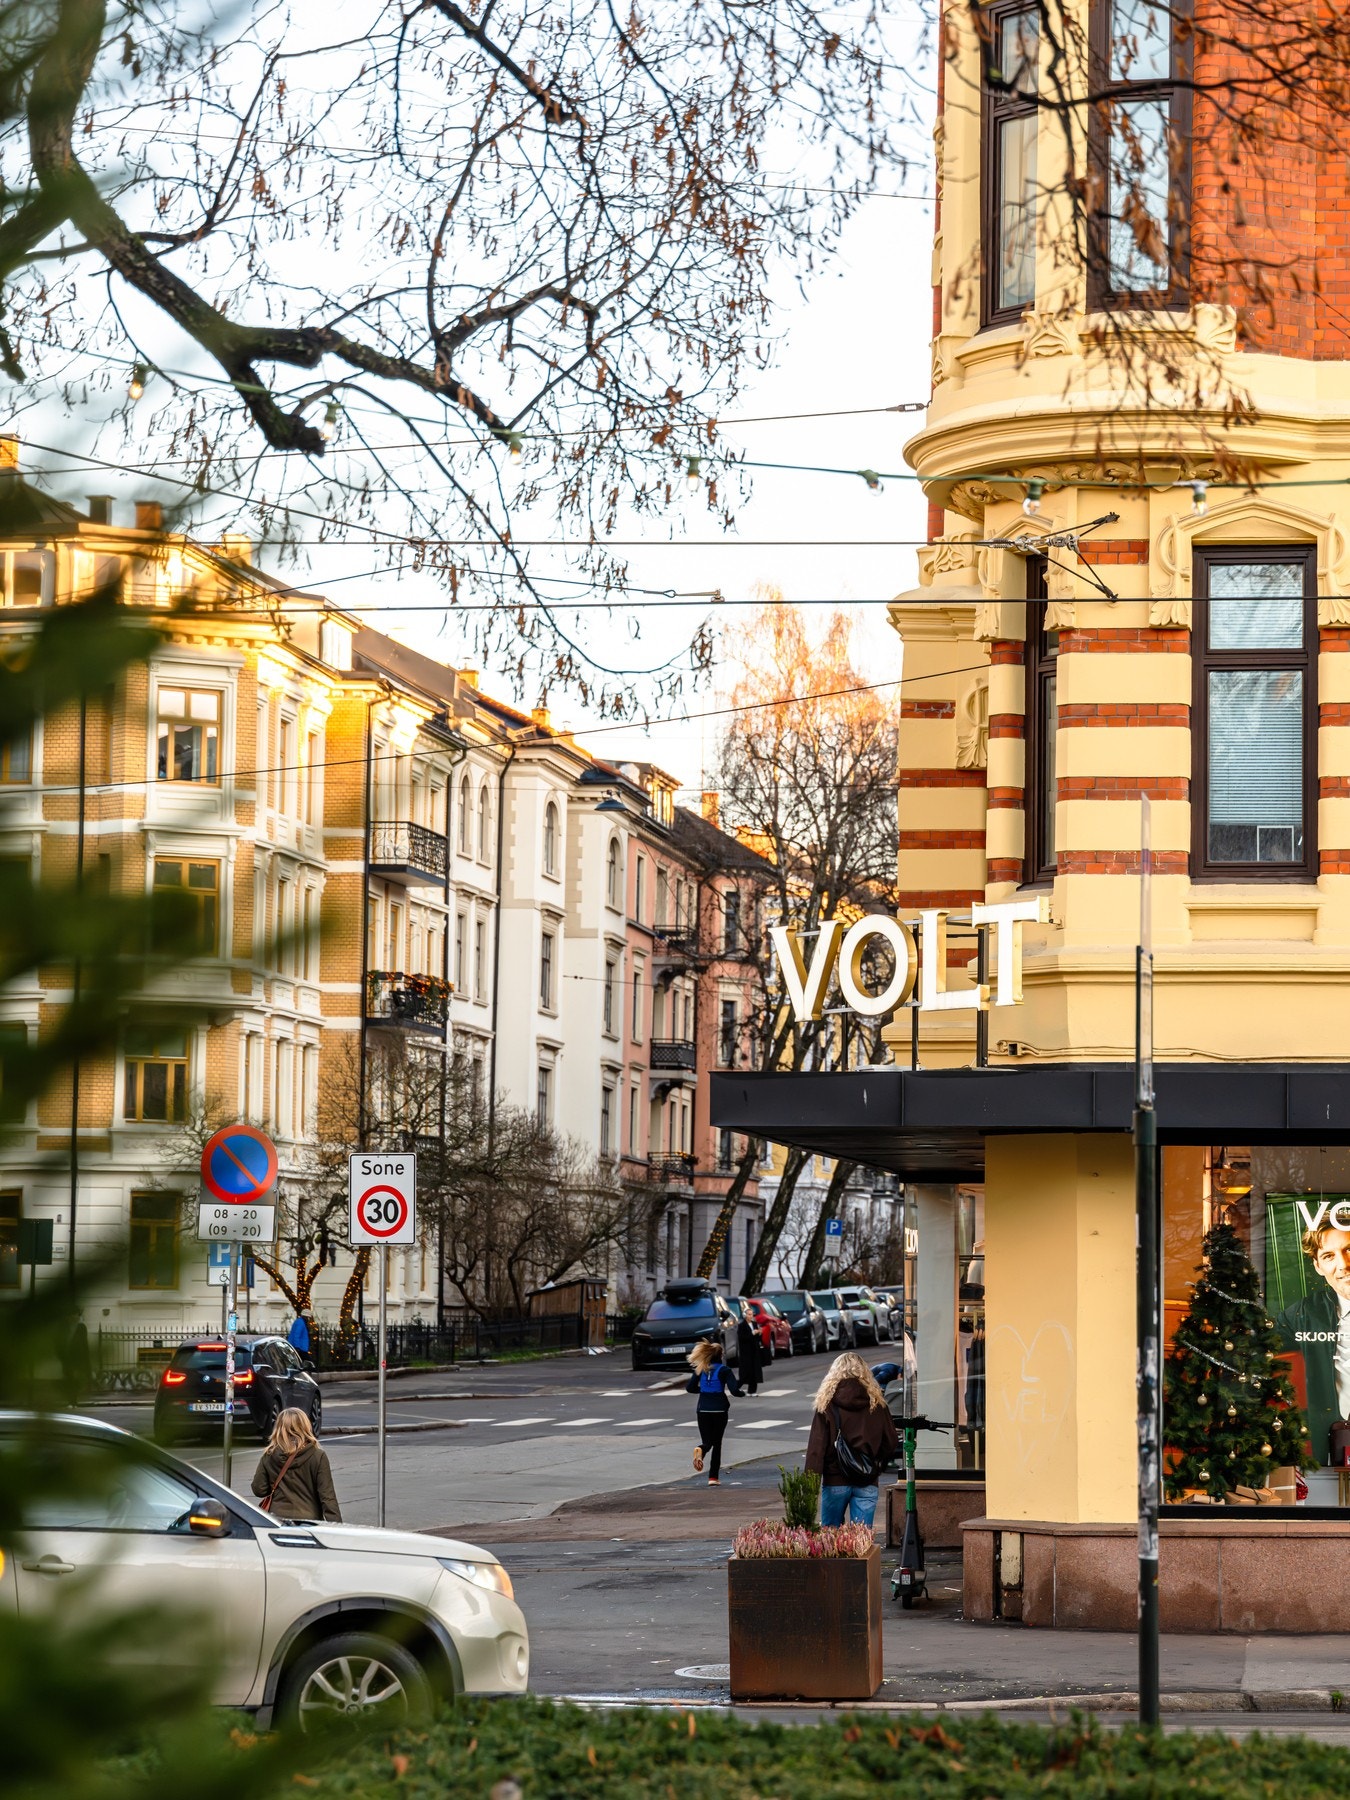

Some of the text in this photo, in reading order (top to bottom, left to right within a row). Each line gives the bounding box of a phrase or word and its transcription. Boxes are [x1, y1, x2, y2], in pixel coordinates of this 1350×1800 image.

[768, 896, 1050, 1022] VOLT
[361, 1160, 405, 1176] Sone
[214, 1208, 228, 1219] 08
[242, 1209, 257, 1220] 20
[366, 1198, 399, 1224] 30
[208, 1222, 228, 1236] (09
[242, 1224, 261, 1237] 20)
[829, 1221, 839, 1234] P
